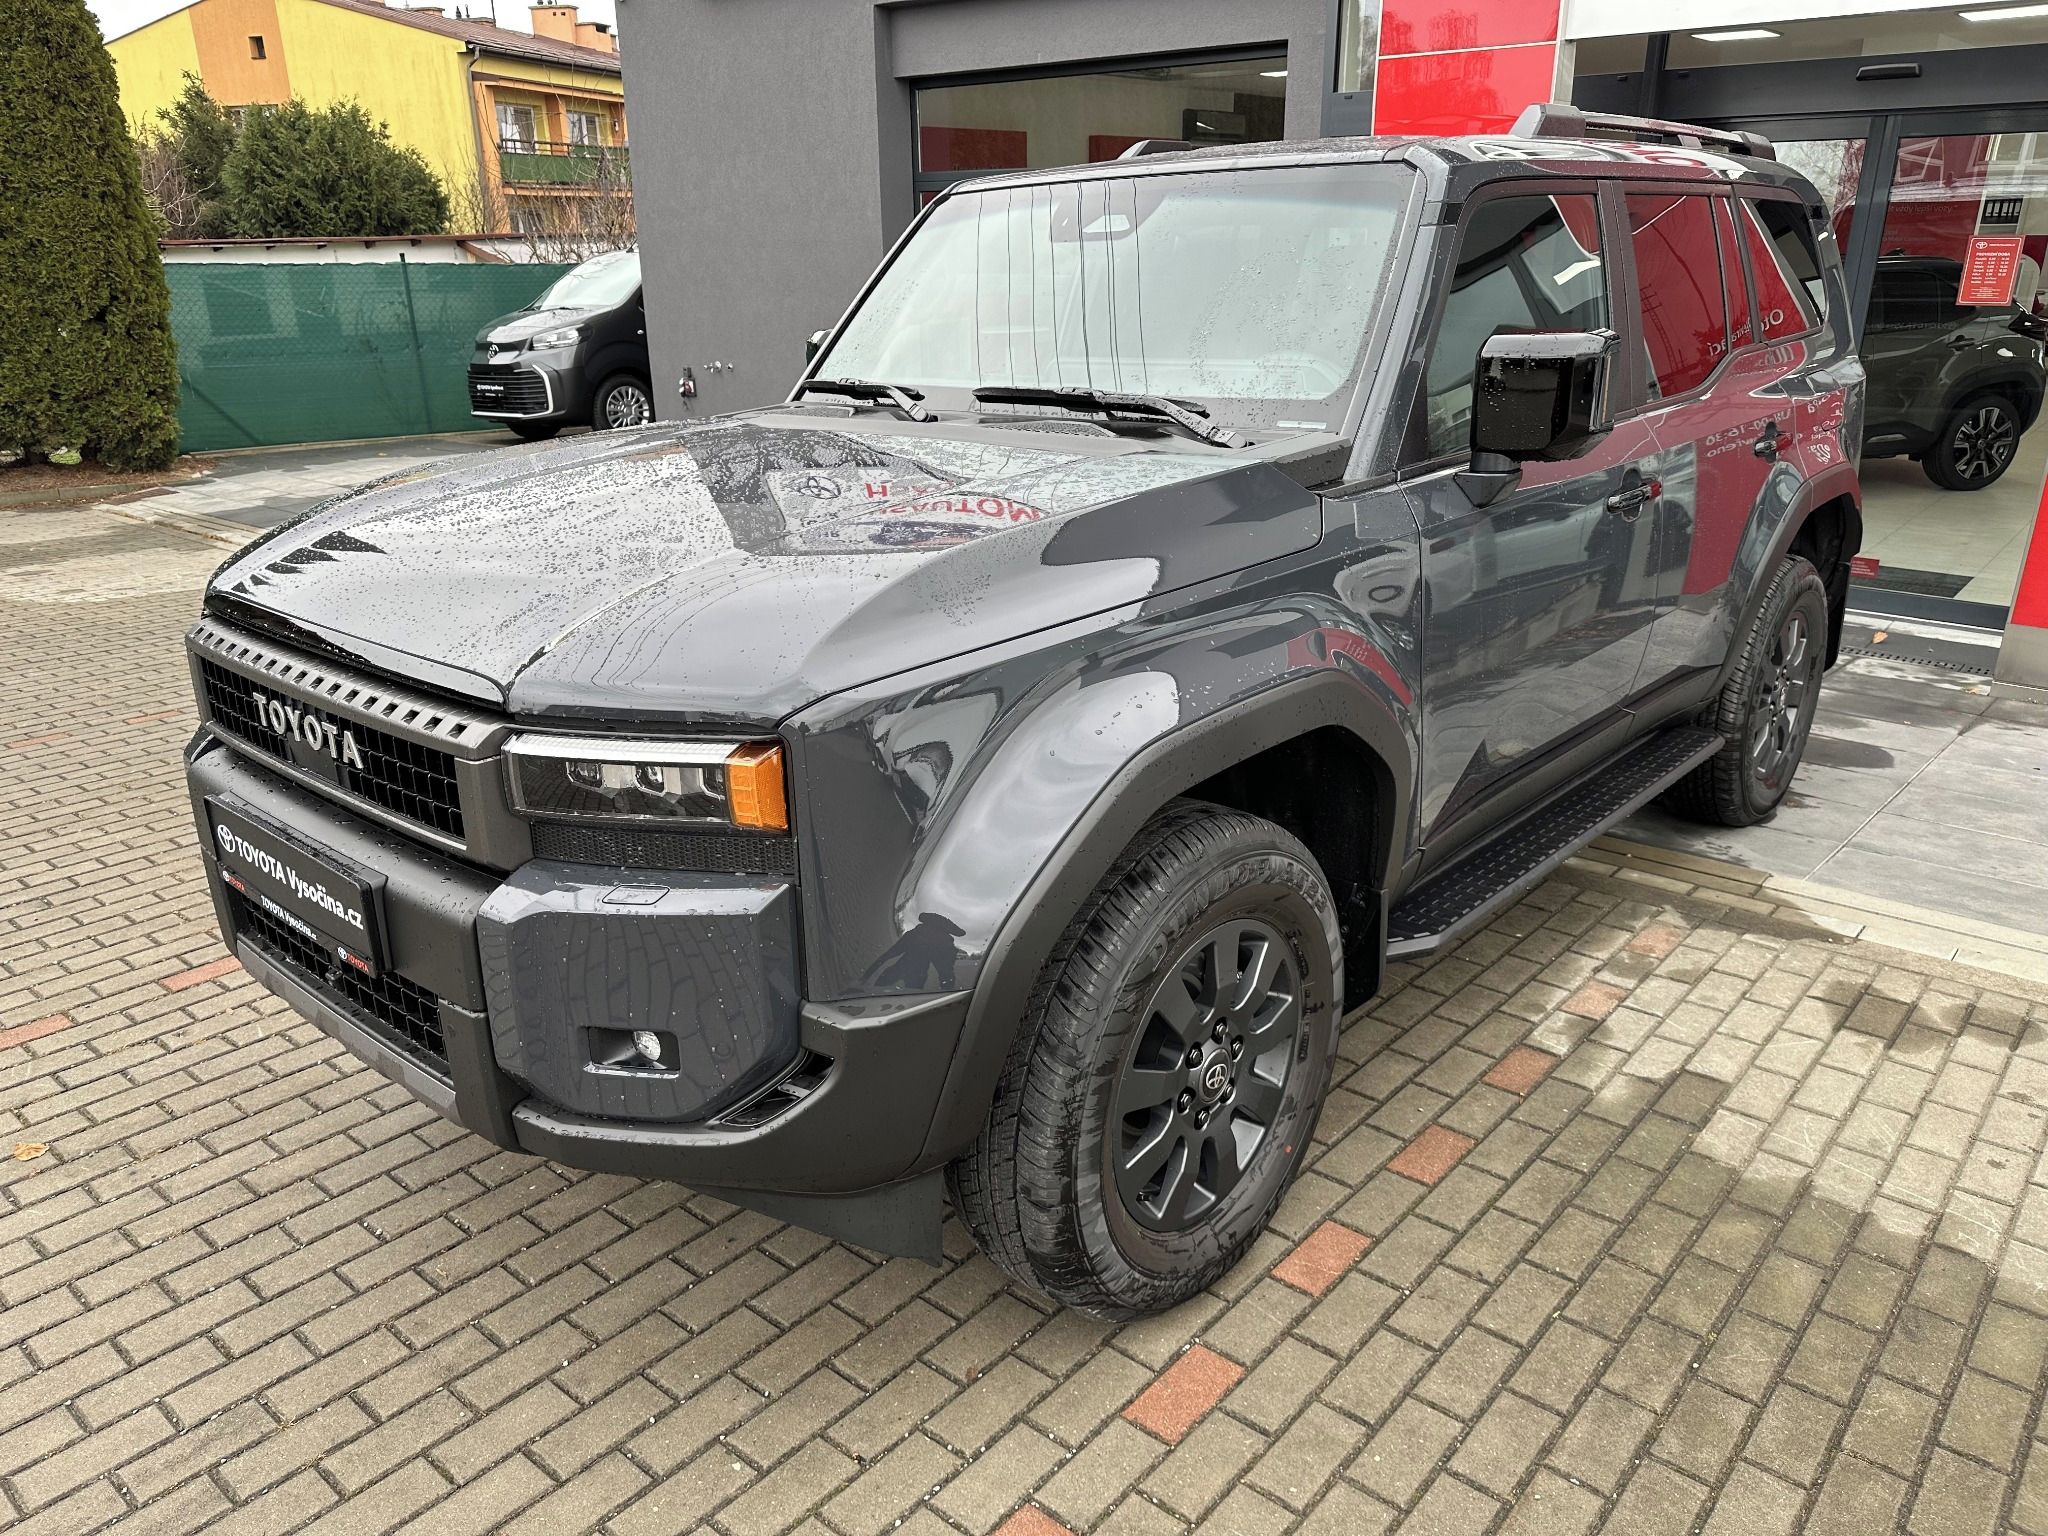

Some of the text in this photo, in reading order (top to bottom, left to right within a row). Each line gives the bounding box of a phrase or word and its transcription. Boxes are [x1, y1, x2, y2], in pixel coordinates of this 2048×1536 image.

[253, 691, 364, 769] TOYOTA
[228, 874, 245, 893] TOYOTA
[235, 836, 364, 930] TOYOTA Vysočina.cz
[261, 895, 285, 919] TOYOTA
[346, 952, 369, 973] TOYOTA
